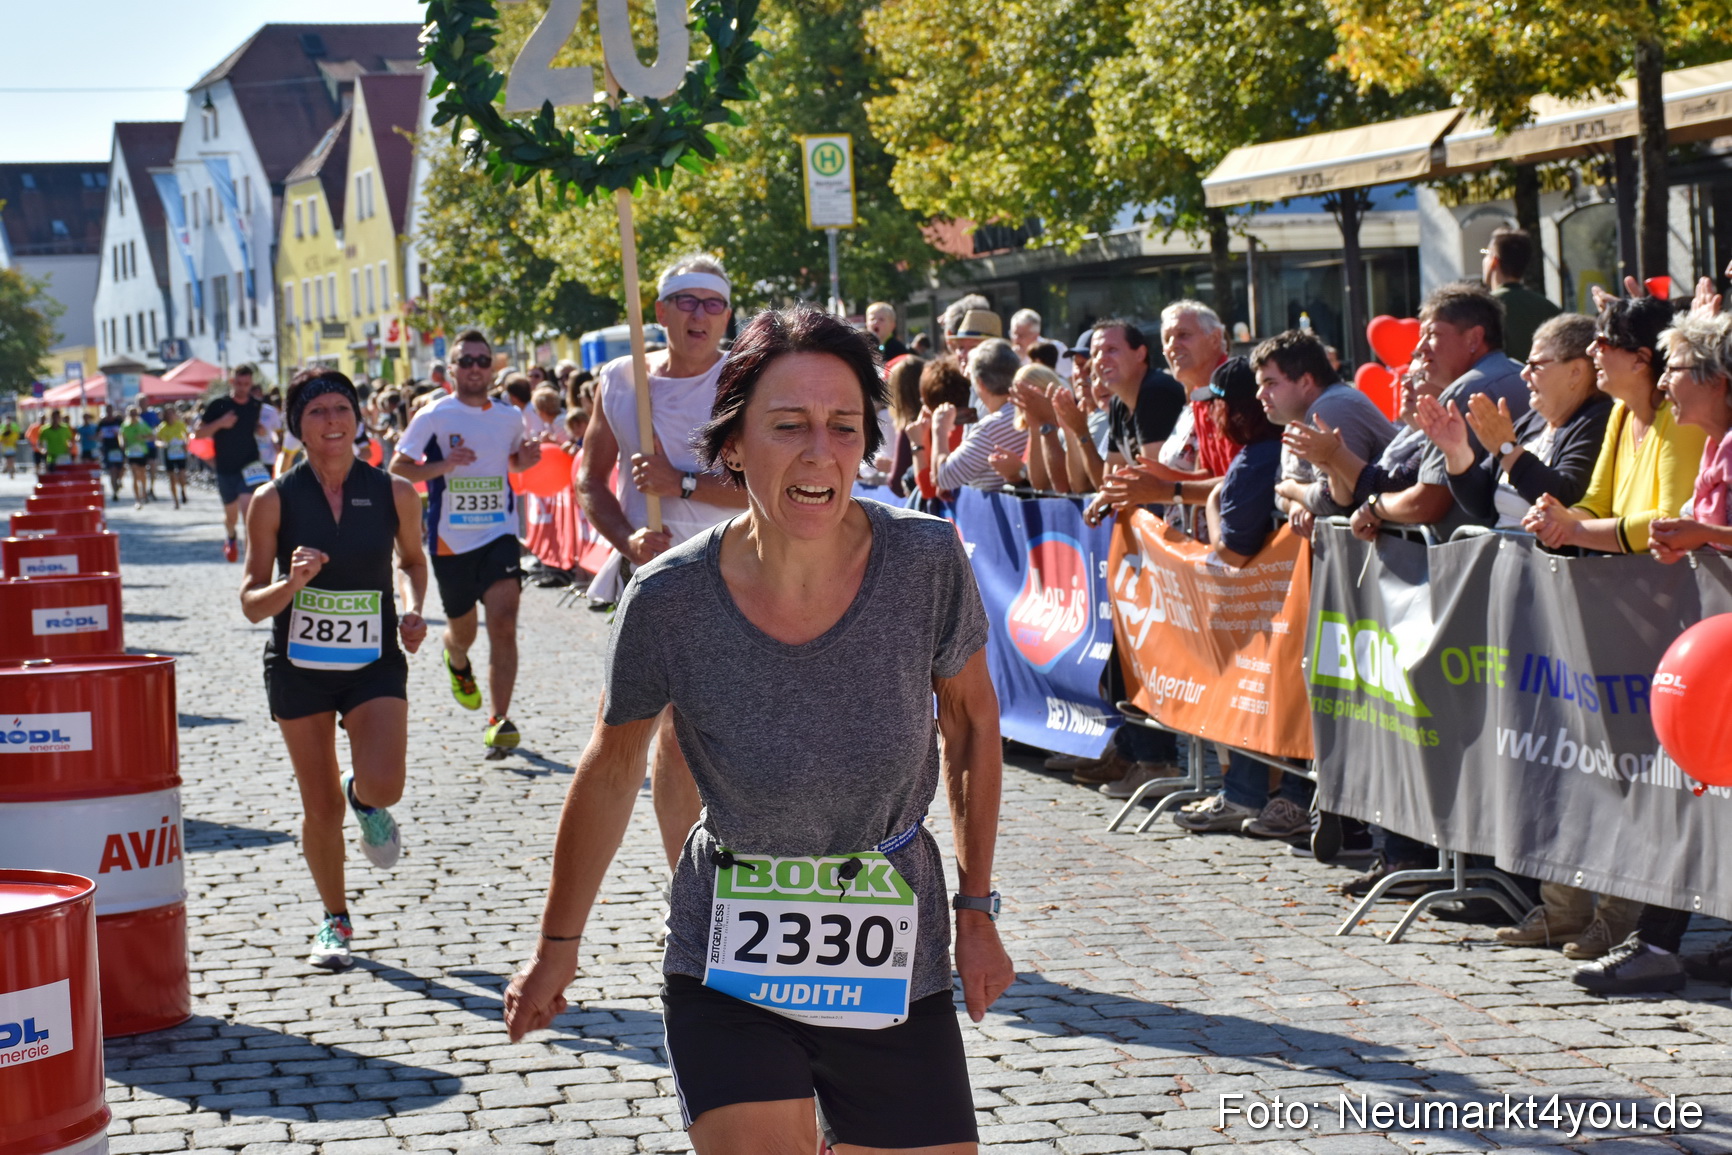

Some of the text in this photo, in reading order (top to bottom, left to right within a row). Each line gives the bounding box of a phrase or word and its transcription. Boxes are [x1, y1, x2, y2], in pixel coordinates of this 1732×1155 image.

[506, 0, 689, 111] 20
[453, 479, 498, 490] BOCK
[456, 494, 498, 510] 2333
[462, 514, 493, 523] TOBIAS
[301, 591, 372, 612] BOCK
[299, 616, 368, 643] 2821
[733, 856, 897, 896] BOCK
[899, 920, 908, 931] D
[735, 911, 894, 967] 2330
[750, 982, 863, 1006] JUDITH
